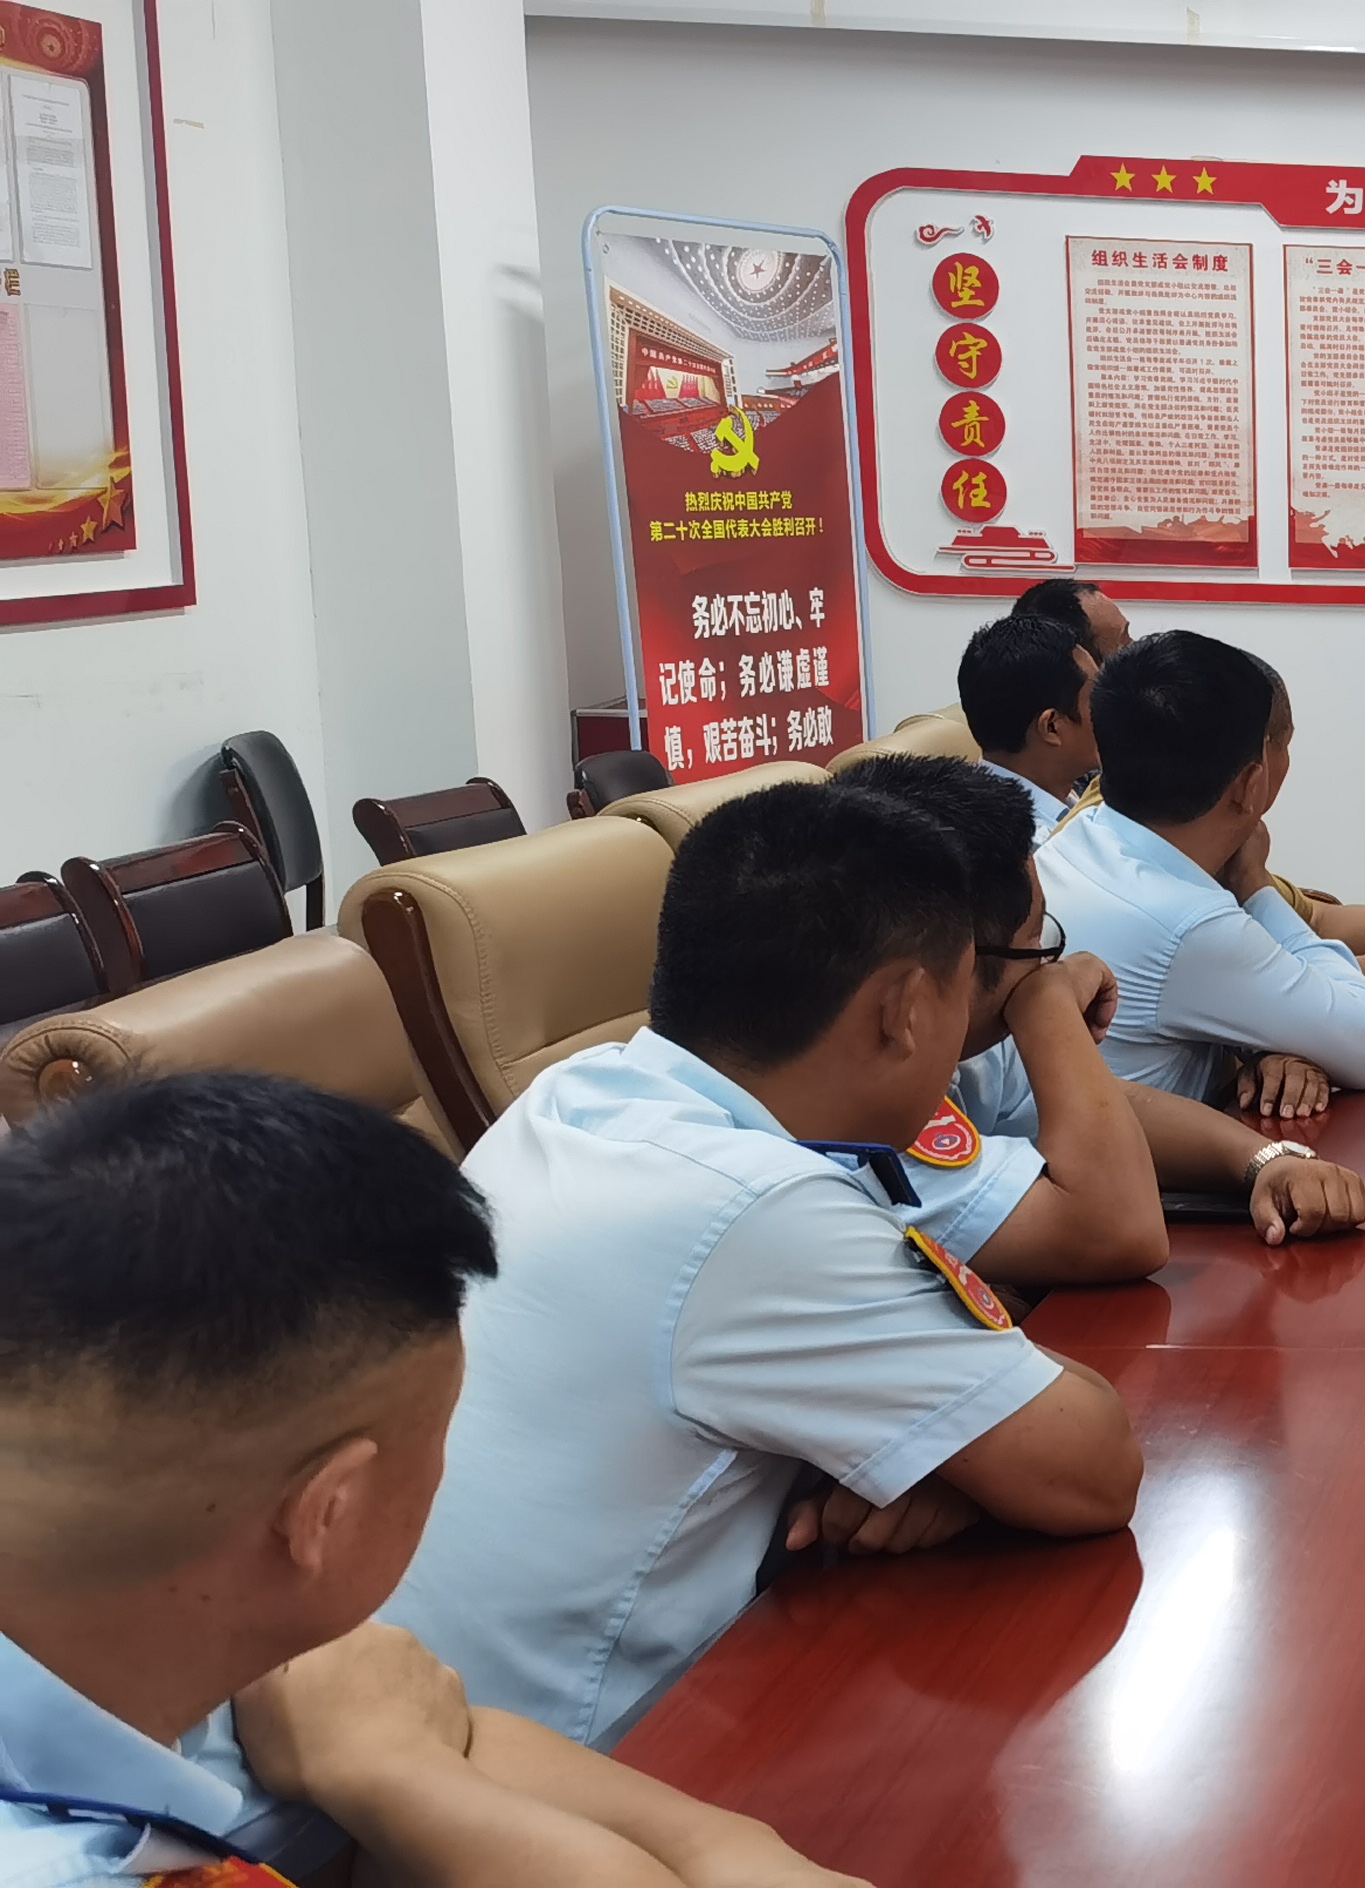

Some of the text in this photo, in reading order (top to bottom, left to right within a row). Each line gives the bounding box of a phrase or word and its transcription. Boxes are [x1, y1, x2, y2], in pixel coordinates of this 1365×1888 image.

[1091, 249, 1229, 272] 组织生活会制度
[948, 261, 991, 510] 坚守责任
[685, 490, 793, 512] 热烈庆祝中国共产党
[649, 517, 824, 542] 第二十次全国代表大会胜利召开！
[692, 587, 826, 640] 务必不忘初心、牢
[659, 646, 830, 706] 记使命；务必谦虚谨
[664, 705, 834, 771] 慎，艰苦奋斗；务必敢
